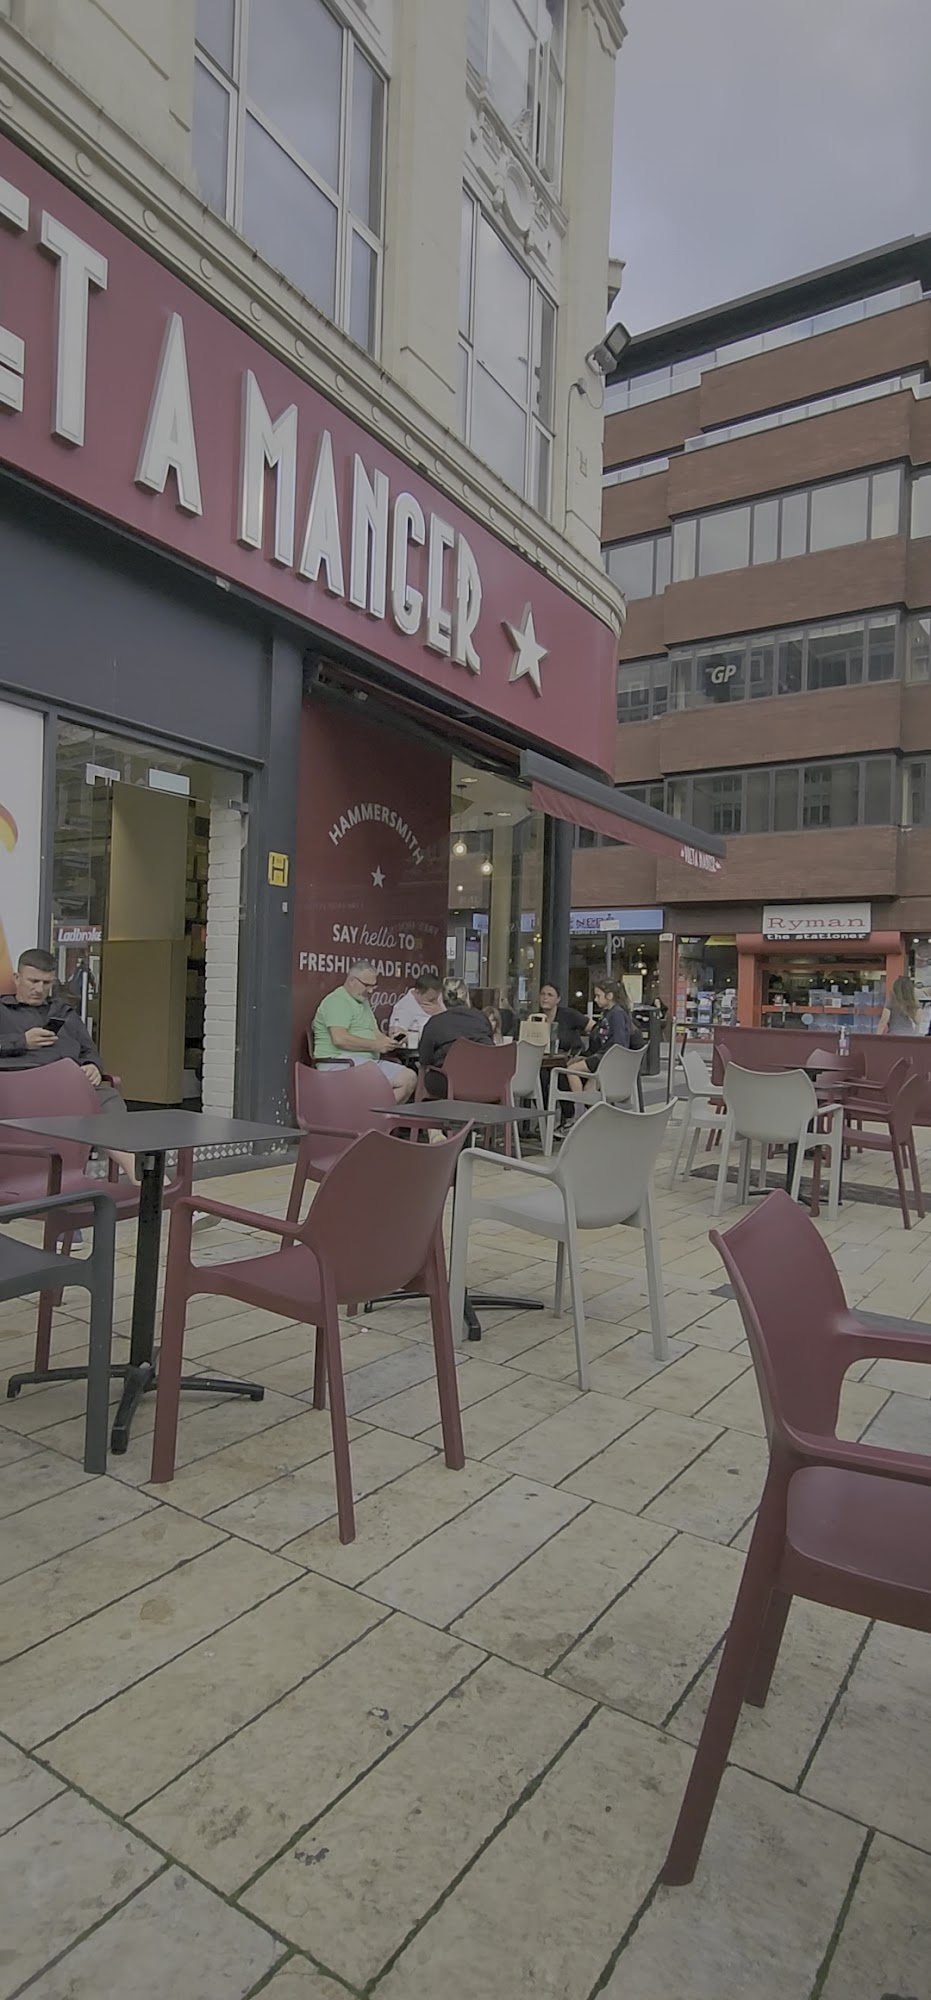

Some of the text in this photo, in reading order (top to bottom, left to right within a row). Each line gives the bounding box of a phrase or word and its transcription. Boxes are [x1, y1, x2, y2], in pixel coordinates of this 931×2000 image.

[134, 312, 203, 518] A
[237, 368, 483, 675] MANGER
[711, 665, 737, 684] GP
[329, 803, 424, 864] HAMMERSMITH
[271, 855, 286, 883] H
[332, 924, 359, 944] SAY
[360, 924, 398, 948] hello
[399, 933, 416, 950] TO
[767, 917, 866, 931] Ryman
